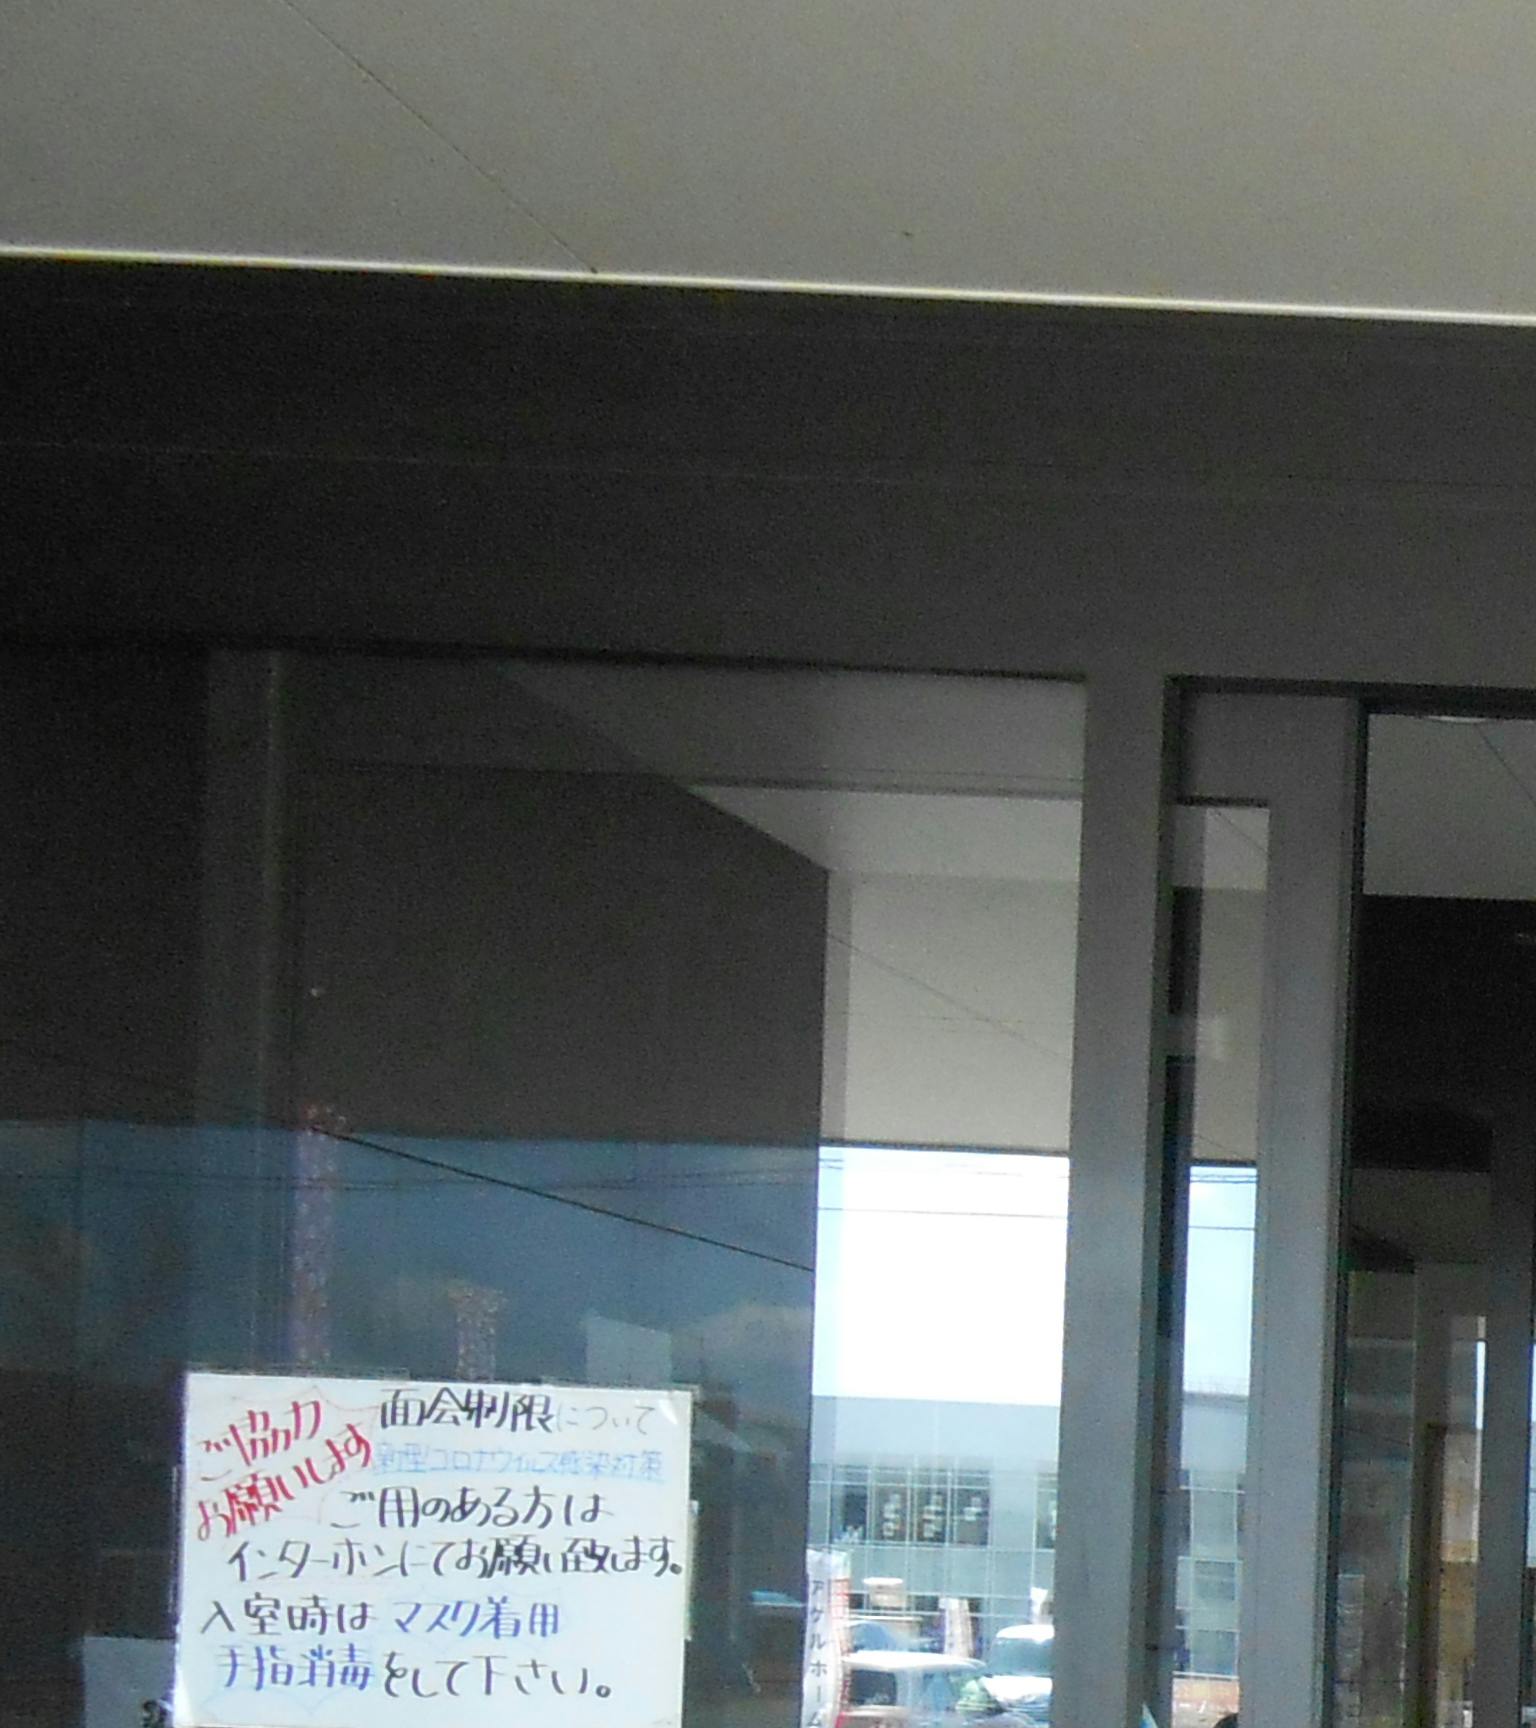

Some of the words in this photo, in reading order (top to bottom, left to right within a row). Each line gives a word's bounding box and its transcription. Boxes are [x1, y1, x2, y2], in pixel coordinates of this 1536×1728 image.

[330, 1484, 614, 1529] ご用のある方は
